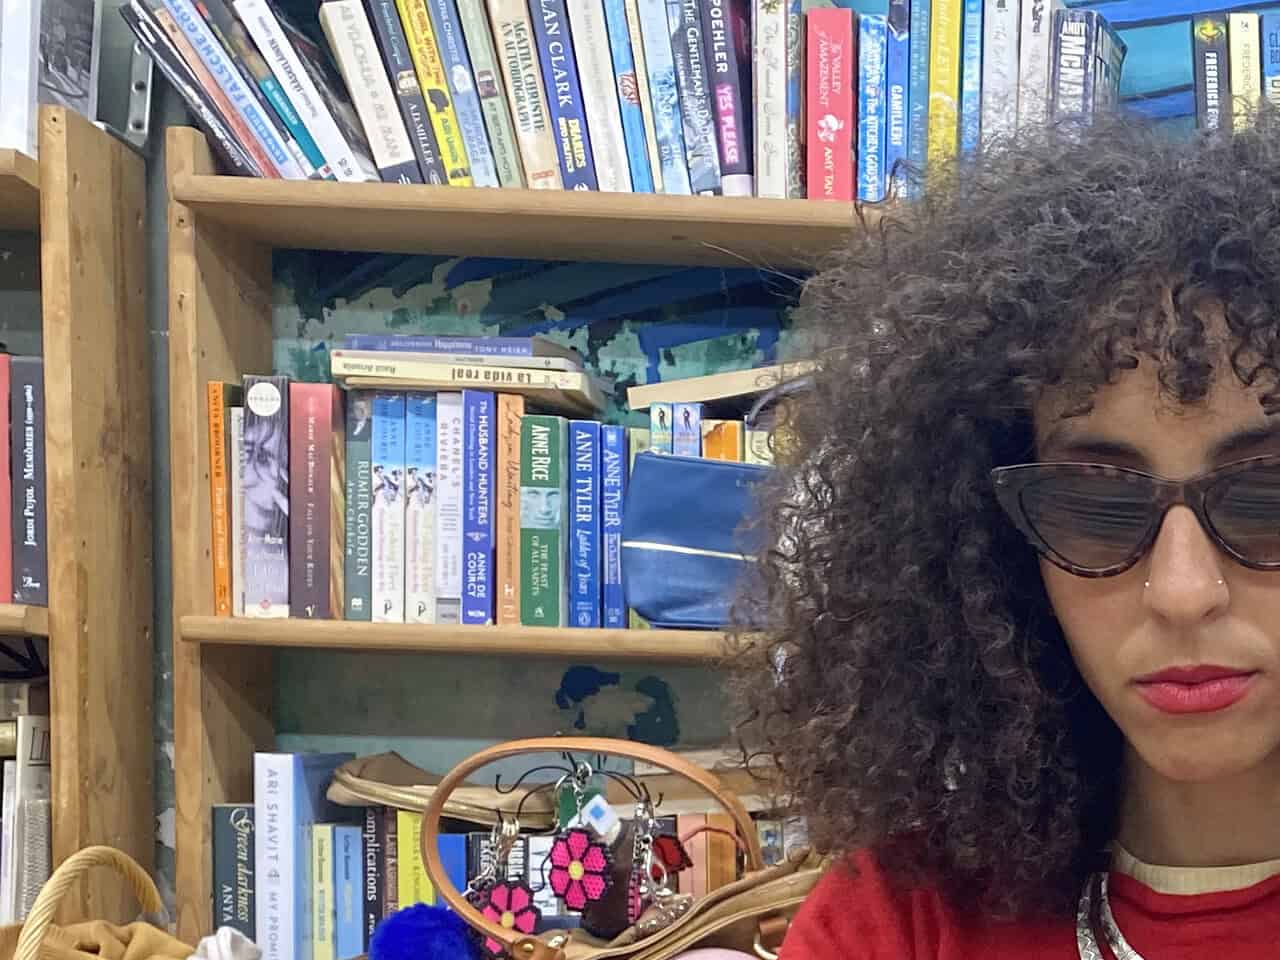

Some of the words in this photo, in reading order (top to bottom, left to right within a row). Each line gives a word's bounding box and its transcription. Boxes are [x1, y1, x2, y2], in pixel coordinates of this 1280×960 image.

[506, 40, 531, 132] AUTOBIOGRAPHY
[513, 20, 532, 71] AGATHA
[524, 72, 545, 133] CHRISTIE
[549, 44, 574, 108] CLARK
[687, 27, 707, 106] GENTLEMAN'S
[818, 40, 829, 108] AMAZEMENT
[831, 56, 842, 95] VALLEY
[716, 83, 734, 111] YES
[890, 85, 904, 146] CAMILLERI
[568, 118, 588, 168] DIARIES
[720, 113, 740, 166] PLEASE
[866, 115, 879, 154] KITCHEN
[823, 147, 835, 173] AMY
[824, 174, 835, 197] TAN
[451, 367, 480, 381] real
[483, 370, 514, 384] vida
[516, 372, 532, 384] La
[479, 400, 488, 414] The
[439, 422, 449, 481] RIVIERA
[451, 416, 462, 489] CHANEL'S
[478, 415, 489, 469] HUSBAND
[531, 424, 550, 454] ANNE
[576, 430, 592, 471] ANNE
[357, 460, 369, 510] RUMER
[531, 455, 550, 481] RICE
[603, 449, 620, 488] ANNE
[24, 486, 37, 516] PUJOL
[477, 472, 489, 525] HUNTERS
[576, 476, 592, 522] TYLER
[604, 489, 621, 527] TYLER
[357, 513, 369, 577] GODDEN
[576, 528, 592, 558] Ladder
[466, 552, 477, 598] COURCY
[477, 552, 487, 581] ANNE
[540, 562, 549, 588] FEAST
[477, 584, 486, 598] DE
[266, 768, 280, 795] ARI
[230, 806, 255, 862] Green
[266, 802, 281, 863] SHAVIT
[362, 812, 381, 902] omplications
[222, 883, 234, 923] ANYA
[236, 861, 254, 923] darkness
[269, 891, 280, 906] MY
